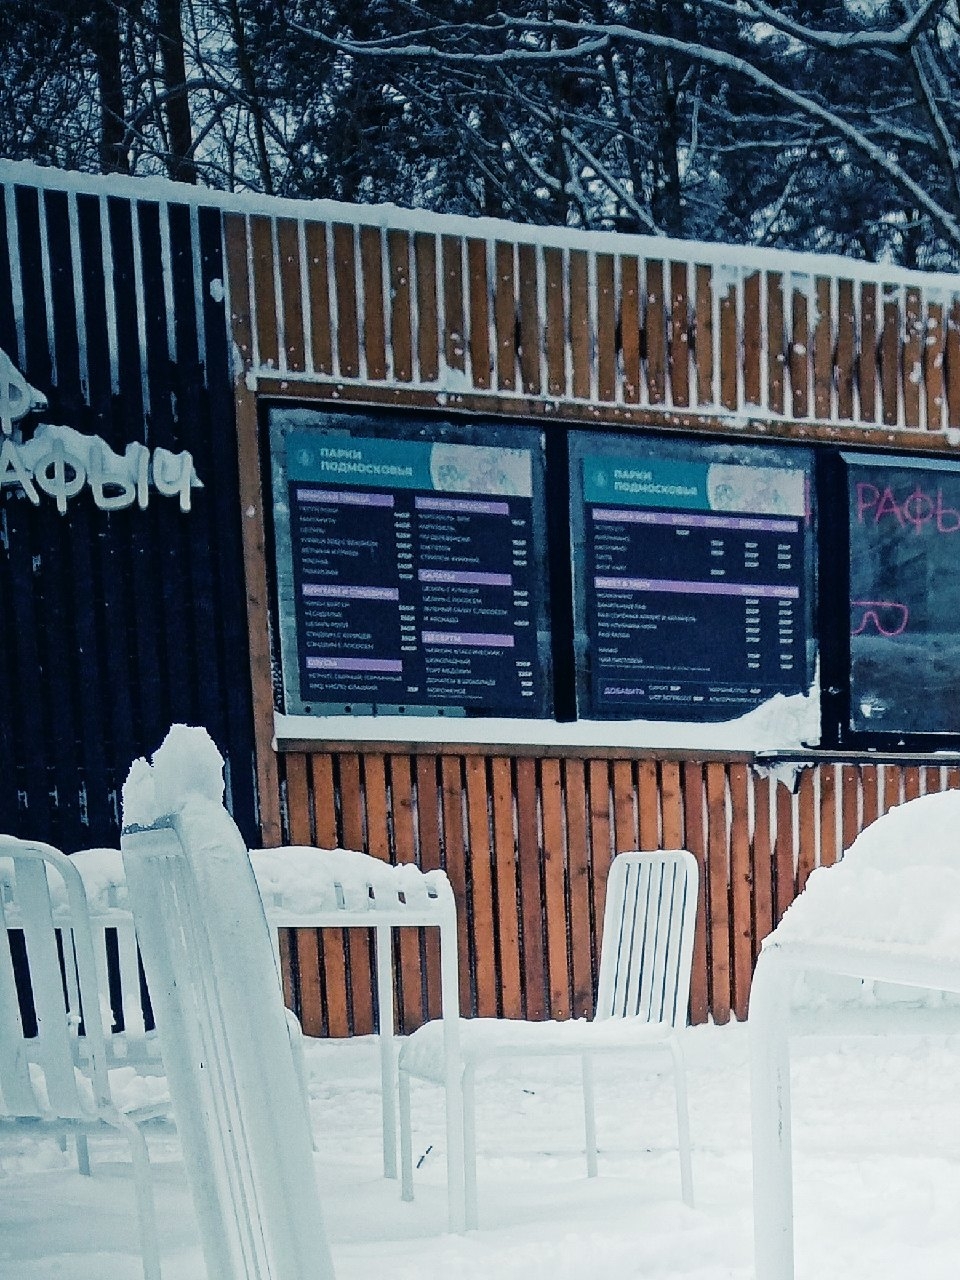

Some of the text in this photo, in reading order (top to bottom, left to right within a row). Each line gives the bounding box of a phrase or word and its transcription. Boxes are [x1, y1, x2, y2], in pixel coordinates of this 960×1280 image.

[320, 448, 361, 460] ПАРКИ
[320, 461, 412, 476] ПОДМОСКОВЬЯ
[614, 469, 652, 480] ПАРКИ
[614, 481, 697, 496] ПОДМОСКОВЬЯ
